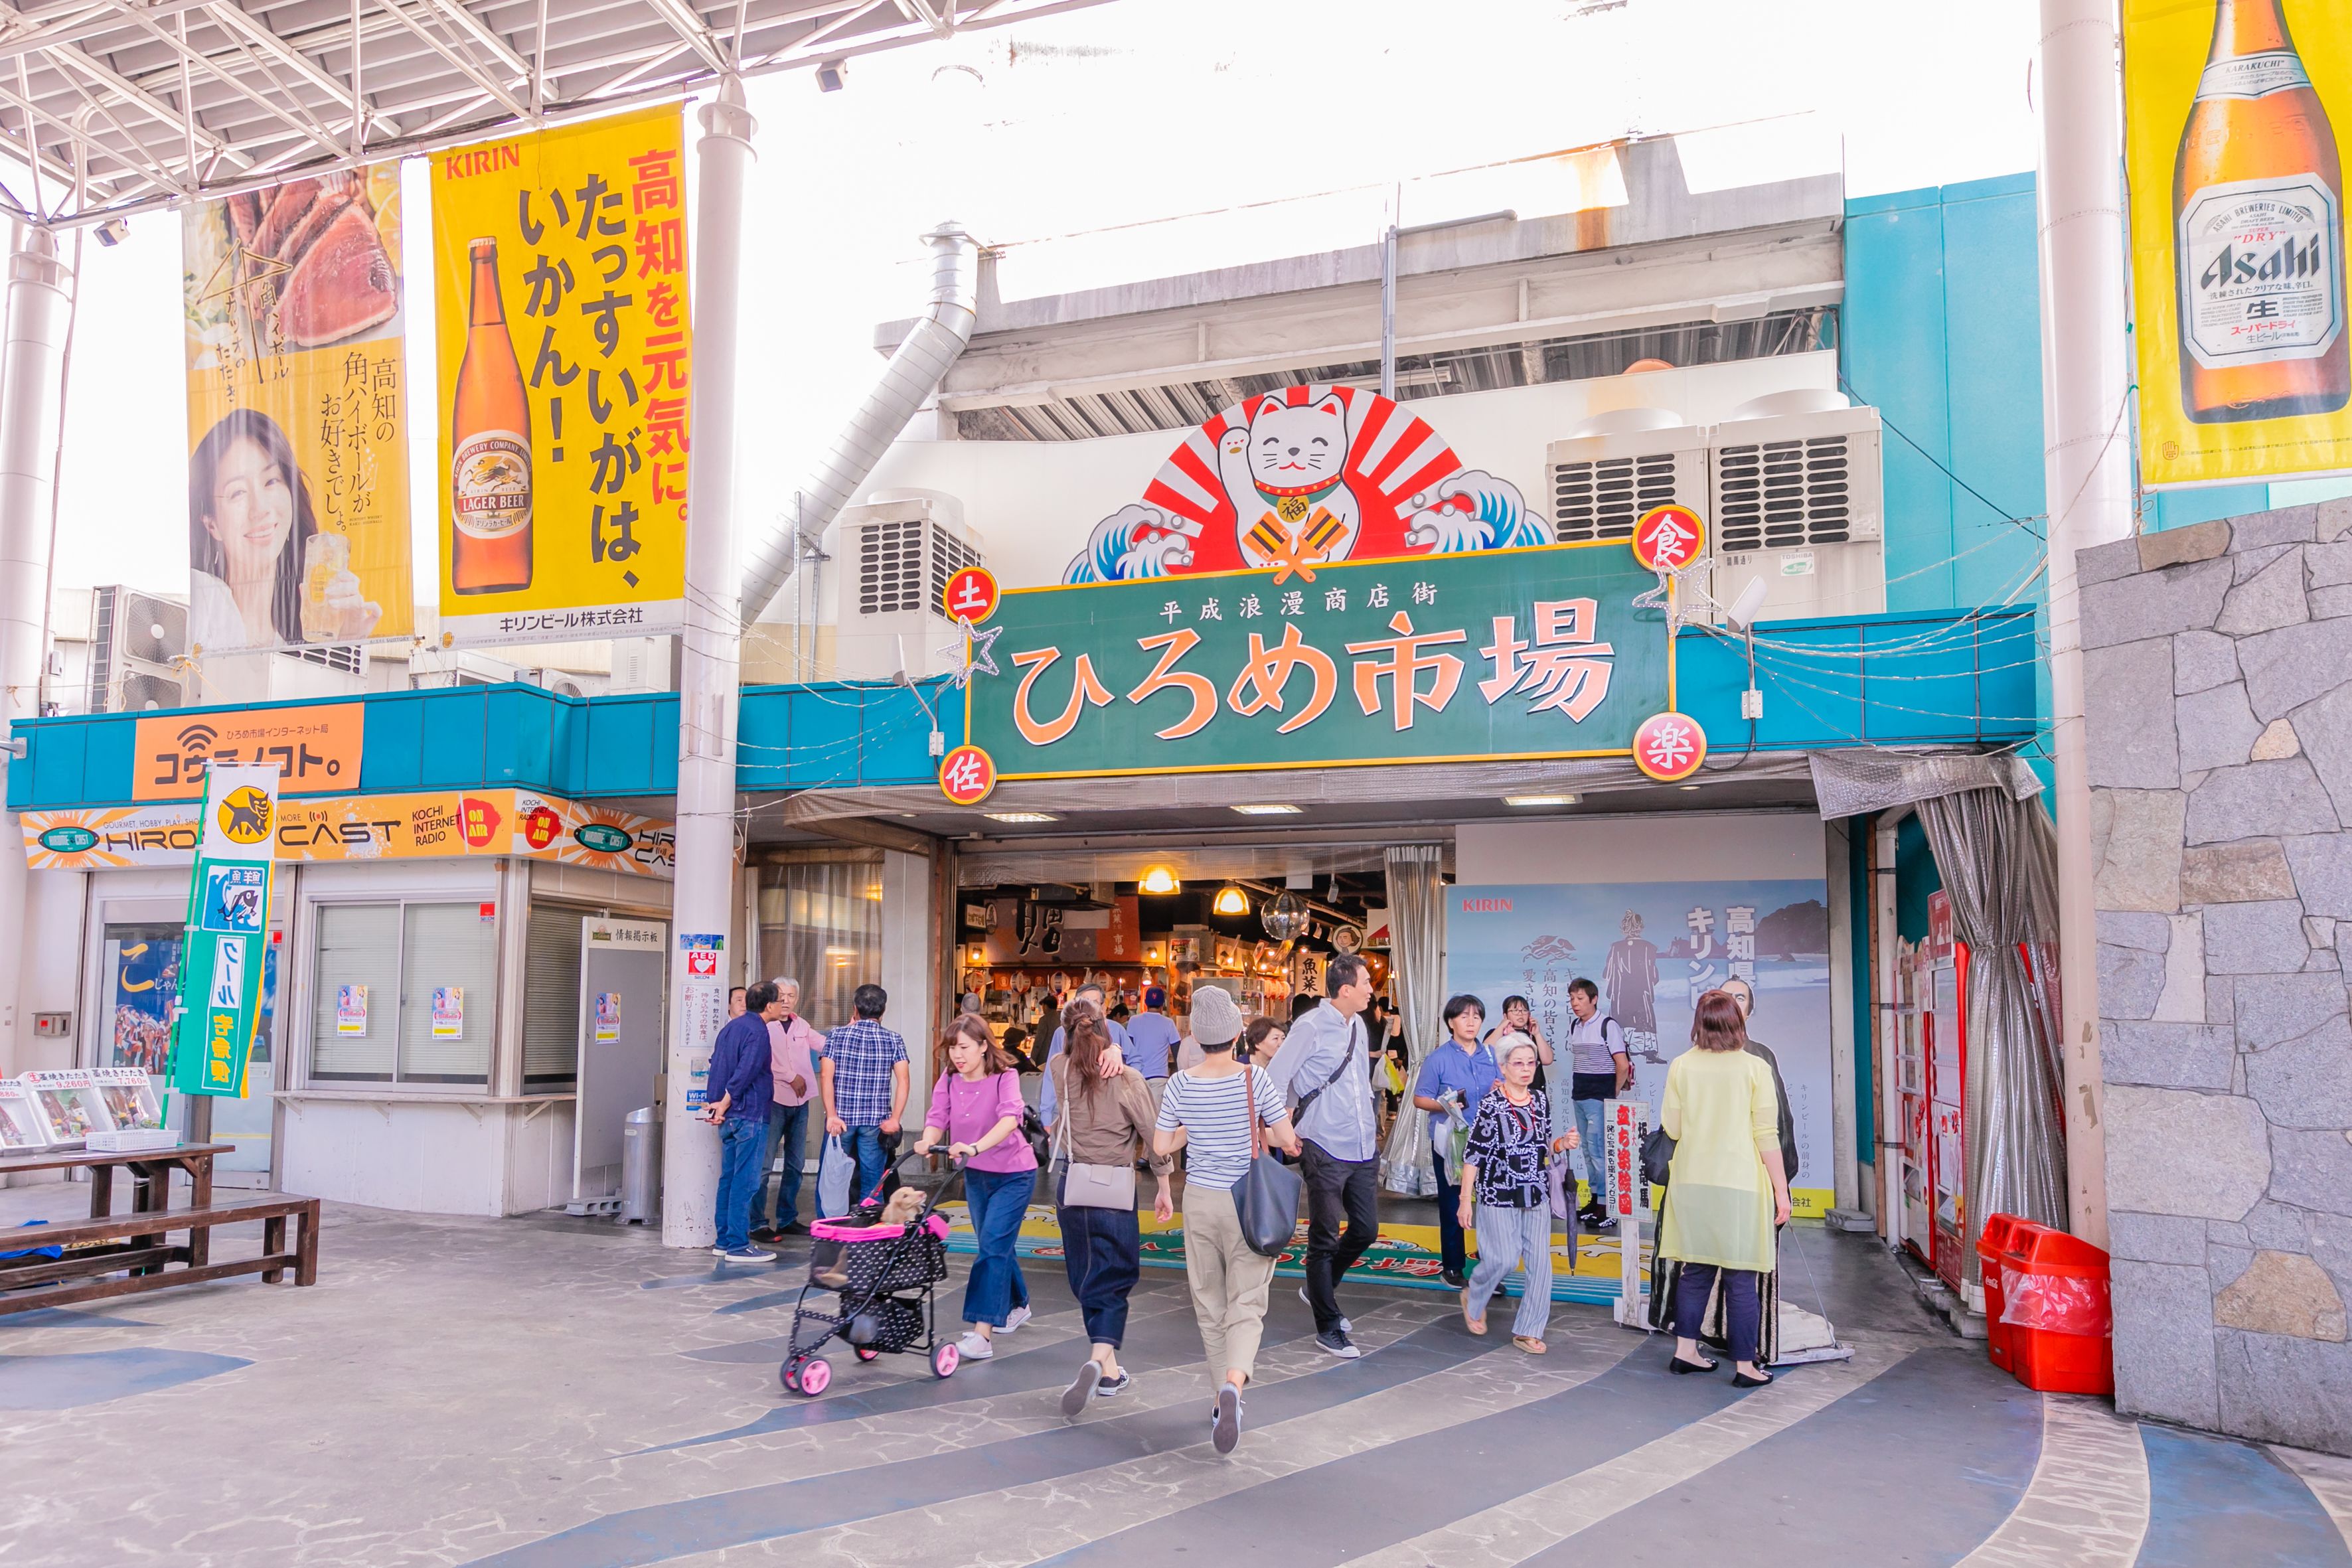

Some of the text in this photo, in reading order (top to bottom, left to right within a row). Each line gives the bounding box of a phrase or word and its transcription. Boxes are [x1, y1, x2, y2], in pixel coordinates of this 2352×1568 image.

[446, 143, 519, 180] KIRIN
[2213, 203, 2304, 232] ASAHI BREWERIES LIMITED
[2201, 232, 2320, 290] Asahi
[2246, 300, 2279, 319] 生
[226, 295, 246, 368] カツオの
[260, 281, 288, 380] 角ハイボール
[518, 189, 580, 463] いかん!
[627, 149, 690, 523] 高知を元気に。
[2231, 320, 2296, 335] スーパードライ
[2246, 331, 2282, 344] 生ビール
[216, 343, 236, 403] たたき
[575, 173, 641, 588] たっすいがは、
[371, 358, 396, 442] 高知の
[343, 352, 371, 513] 角ハイボールが
[321, 394, 347, 532] お好きでしょ。
[462, 443, 488, 460] BREWERY
[463, 495, 524, 512] LAGER BEER
[1283, 497, 1308, 522] 福
[1643, 514, 1696, 562] 食
[953, 576, 988, 611] 土
[1160, 582, 1438, 625] 平成浪漫商店街
[500, 607, 643, 633] キリンビール株式会社
[1011, 597, 1616, 745] ひろめ市場
[226, 724, 329, 740] ひろめ市場インターネット局
[1646, 722, 1694, 769] 楽
[945, 755, 985, 793] 佐
[104, 820, 138, 829] GOURMET,
[139, 819, 163, 828] HOBBY,
[281, 813, 301, 822] MORE
[412, 805, 443, 821] KOCHI
[413, 814, 461, 830] INTERNET
[469, 809, 484, 823] ON
[537, 817, 550, 828] ON
[106, 829, 204, 852] HIRO
[279, 819, 402, 846] CAST
[416, 831, 446, 846] RADIO
[468, 823, 488, 838] AIR
[532, 828, 550, 841] AIR
[1462, 898, 1513, 913] KIRIN
[615, 929, 658, 942] 情報掲示板
[1113, 933, 1124, 955] 市場
[1726, 906, 1756, 988] 高知県
[1302, 957, 1318, 992] 魚菜
[1522, 969, 1537, 1014] 愛され
[684, 986, 694, 1046] お断りさせていただきます
[699, 992, 709, 1043] 持ち込みでの飲食は、
[56, 1080, 91, 1089] 9,260円
[1800, 1083, 1810, 1179] キリンビールの前身の
